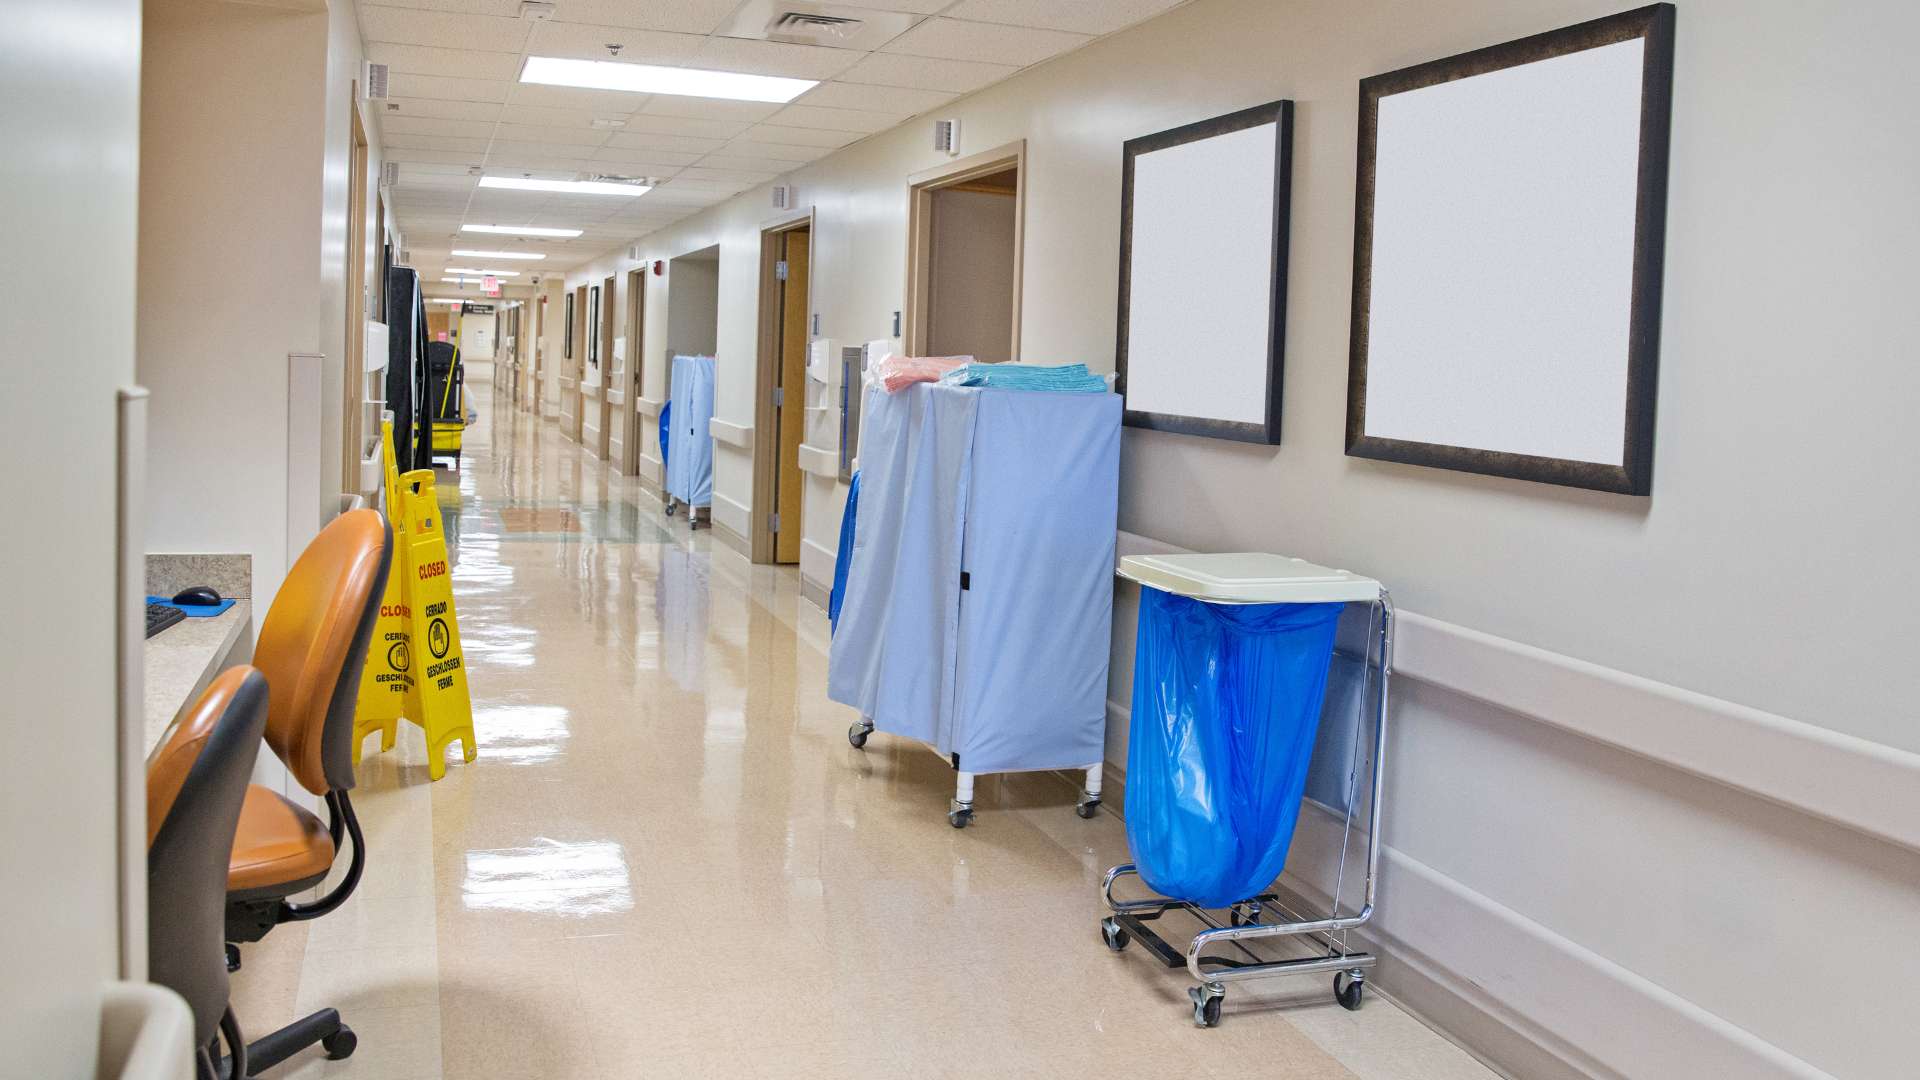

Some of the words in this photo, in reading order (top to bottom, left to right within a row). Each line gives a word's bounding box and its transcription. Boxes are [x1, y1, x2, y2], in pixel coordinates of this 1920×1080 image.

[419, 560, 446, 580] CLOSED
[425, 601, 448, 618] CERRADO
[427, 657, 461, 679] GESCHLOSSEN
